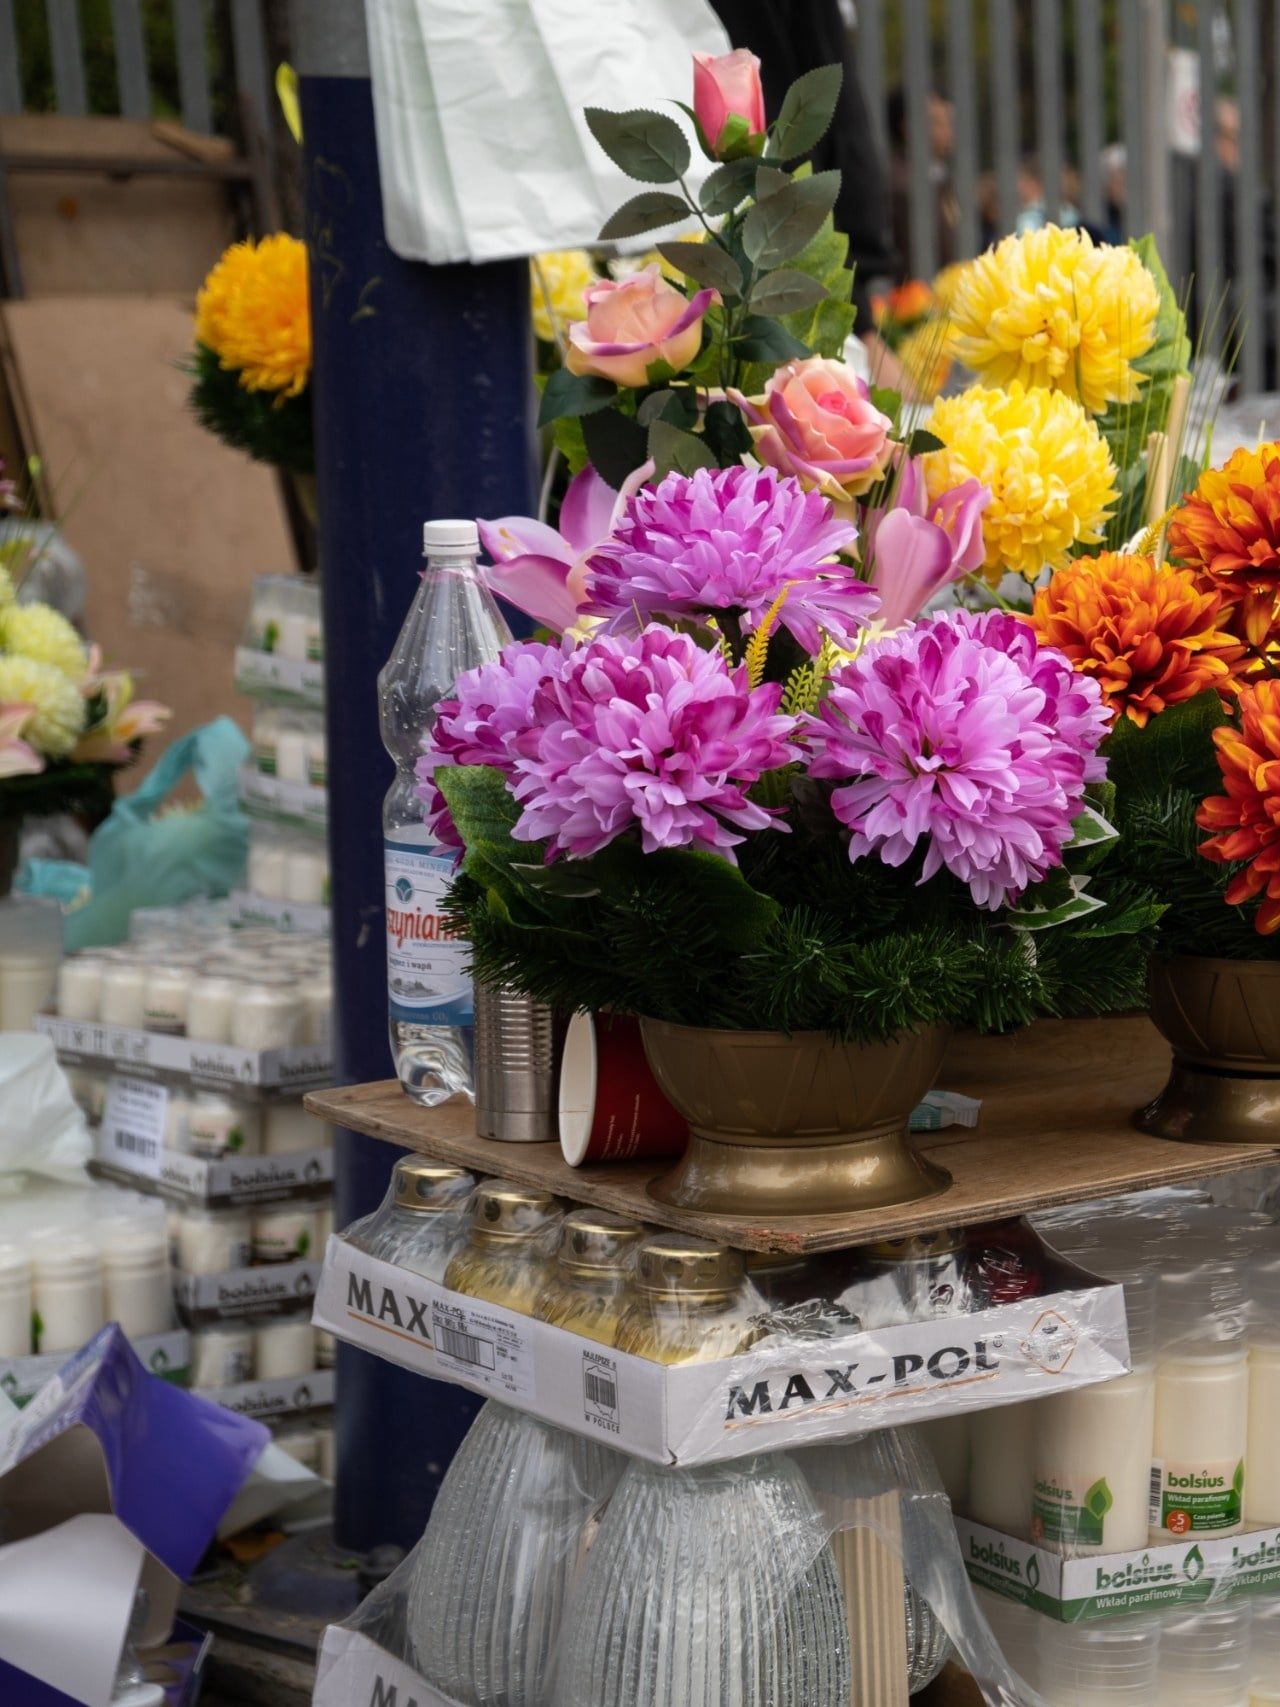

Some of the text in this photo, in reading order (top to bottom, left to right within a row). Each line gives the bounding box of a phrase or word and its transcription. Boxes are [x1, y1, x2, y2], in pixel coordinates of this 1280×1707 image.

[347, 1271, 431, 1340] MAX
[1168, 1470, 1225, 1488] bolsius
[970, 1536, 1020, 1577] bolsius
[1096, 1556, 1174, 1590] bolsius
[1096, 1588, 1183, 1609] Wkład parafinowy
